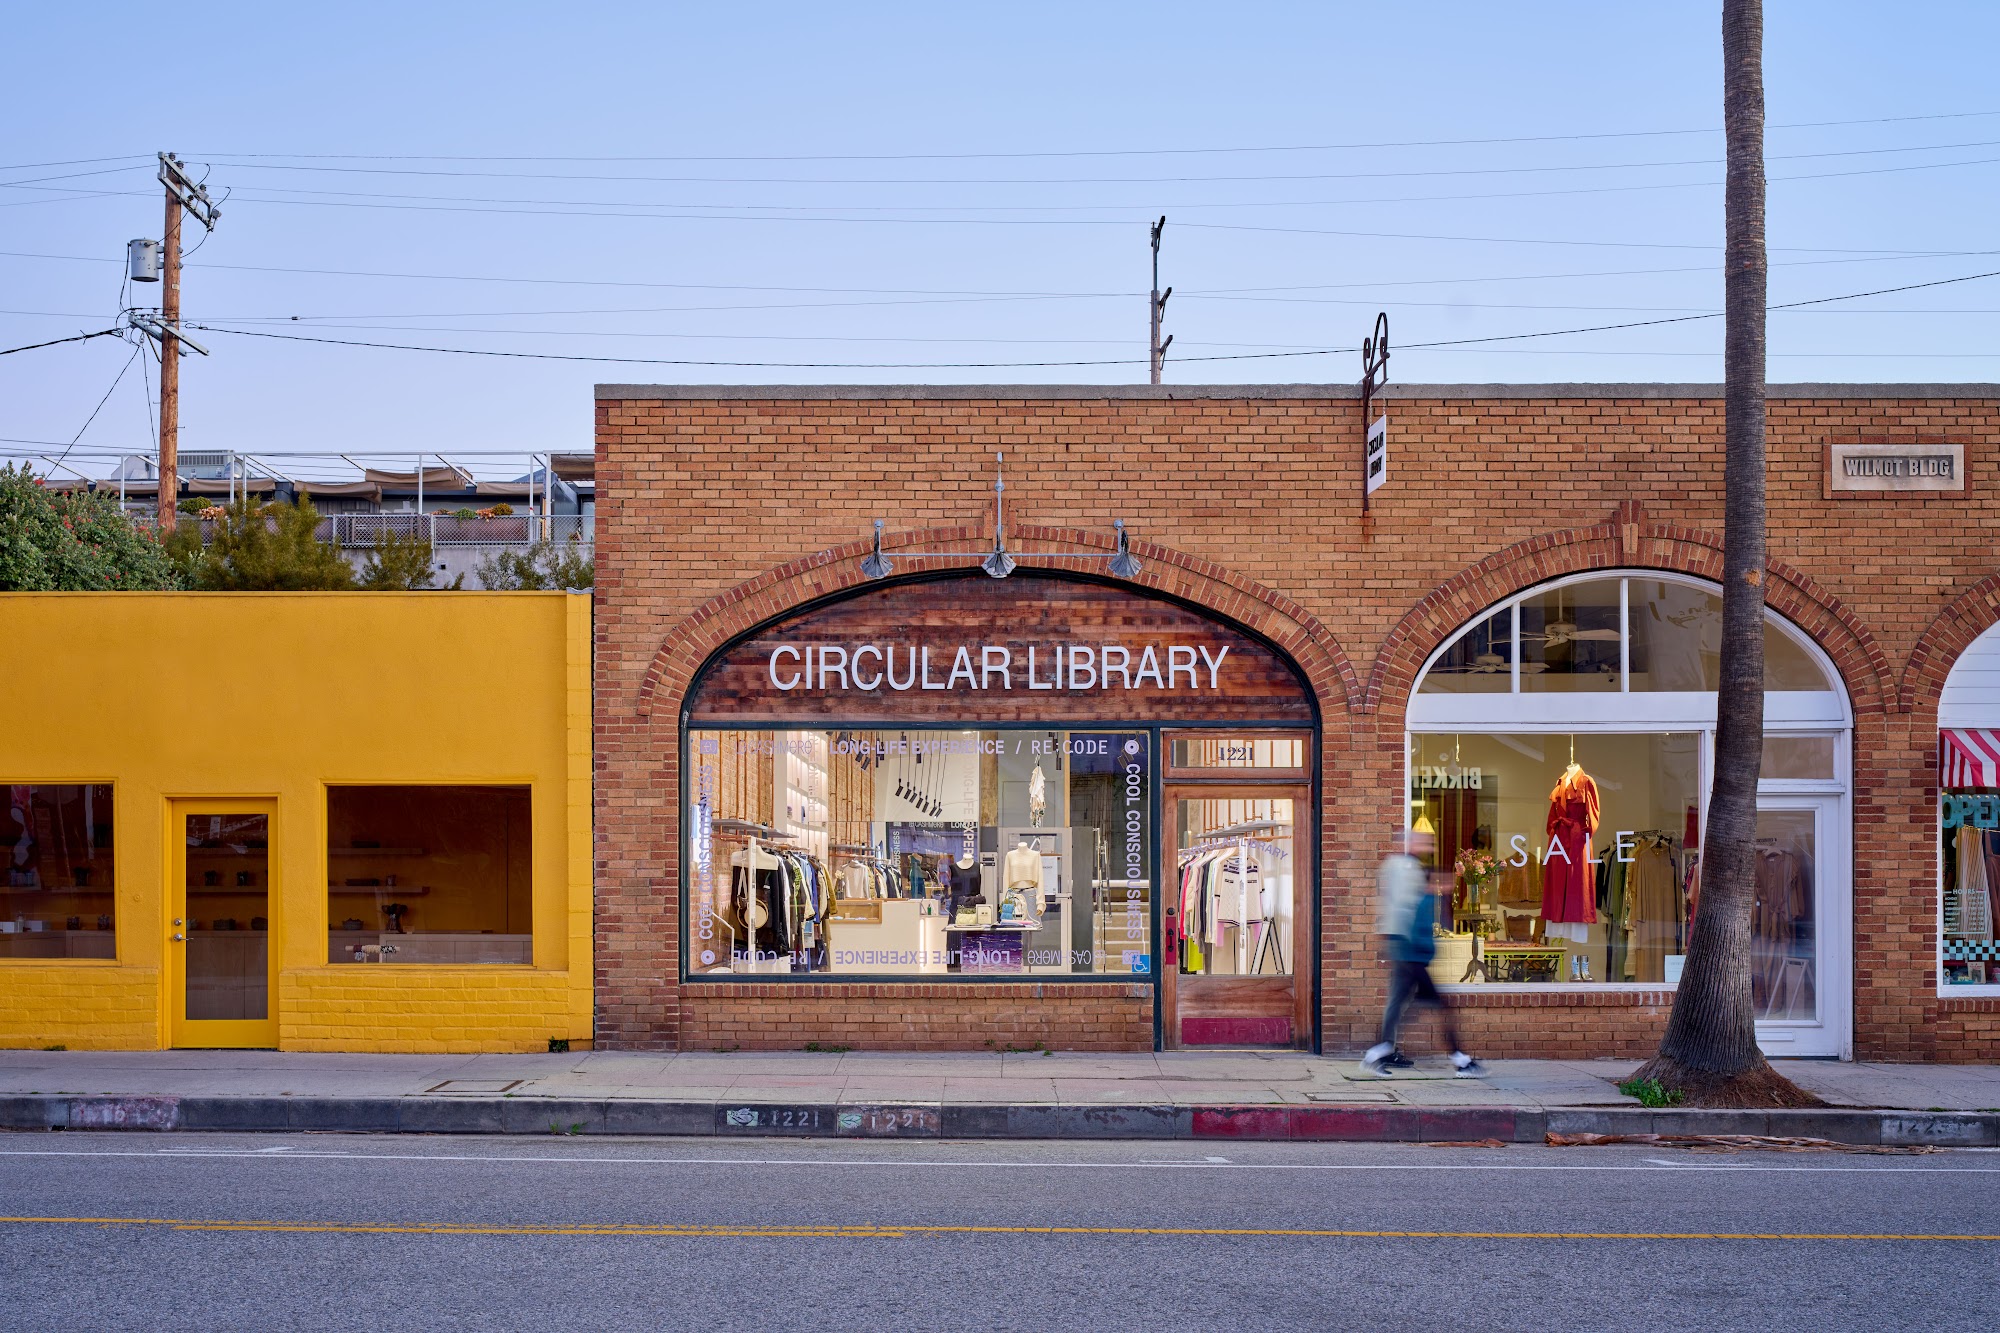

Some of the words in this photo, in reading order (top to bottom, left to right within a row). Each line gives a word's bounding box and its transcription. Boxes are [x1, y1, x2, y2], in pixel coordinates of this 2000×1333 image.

[1845, 459, 1902, 477] WILMOT
[1908, 459, 1949, 477] BLDG
[769, 645, 1011, 690] CIRCULAR
[1028, 645, 1230, 690] LIBRARY
[830, 740, 907, 755] LONG-LIFE
[911, 740, 1004, 755] EXPERIENCE
[1218, 746, 1254, 761] 1221
[1126, 763, 1142, 806] COOL
[1182, 836, 1237, 860] CIRCULAR
[1241, 838, 1288, 860] LIBRARY
[1509, 831, 1636, 867] SALE
[1126, 810, 1142, 939] CONSCIOUSNESS
[836, 951, 928, 965] EXPERIENCE
[933, 951, 1011, 965] LONG-LIFE
[871, 1113, 925, 1130] 1221
